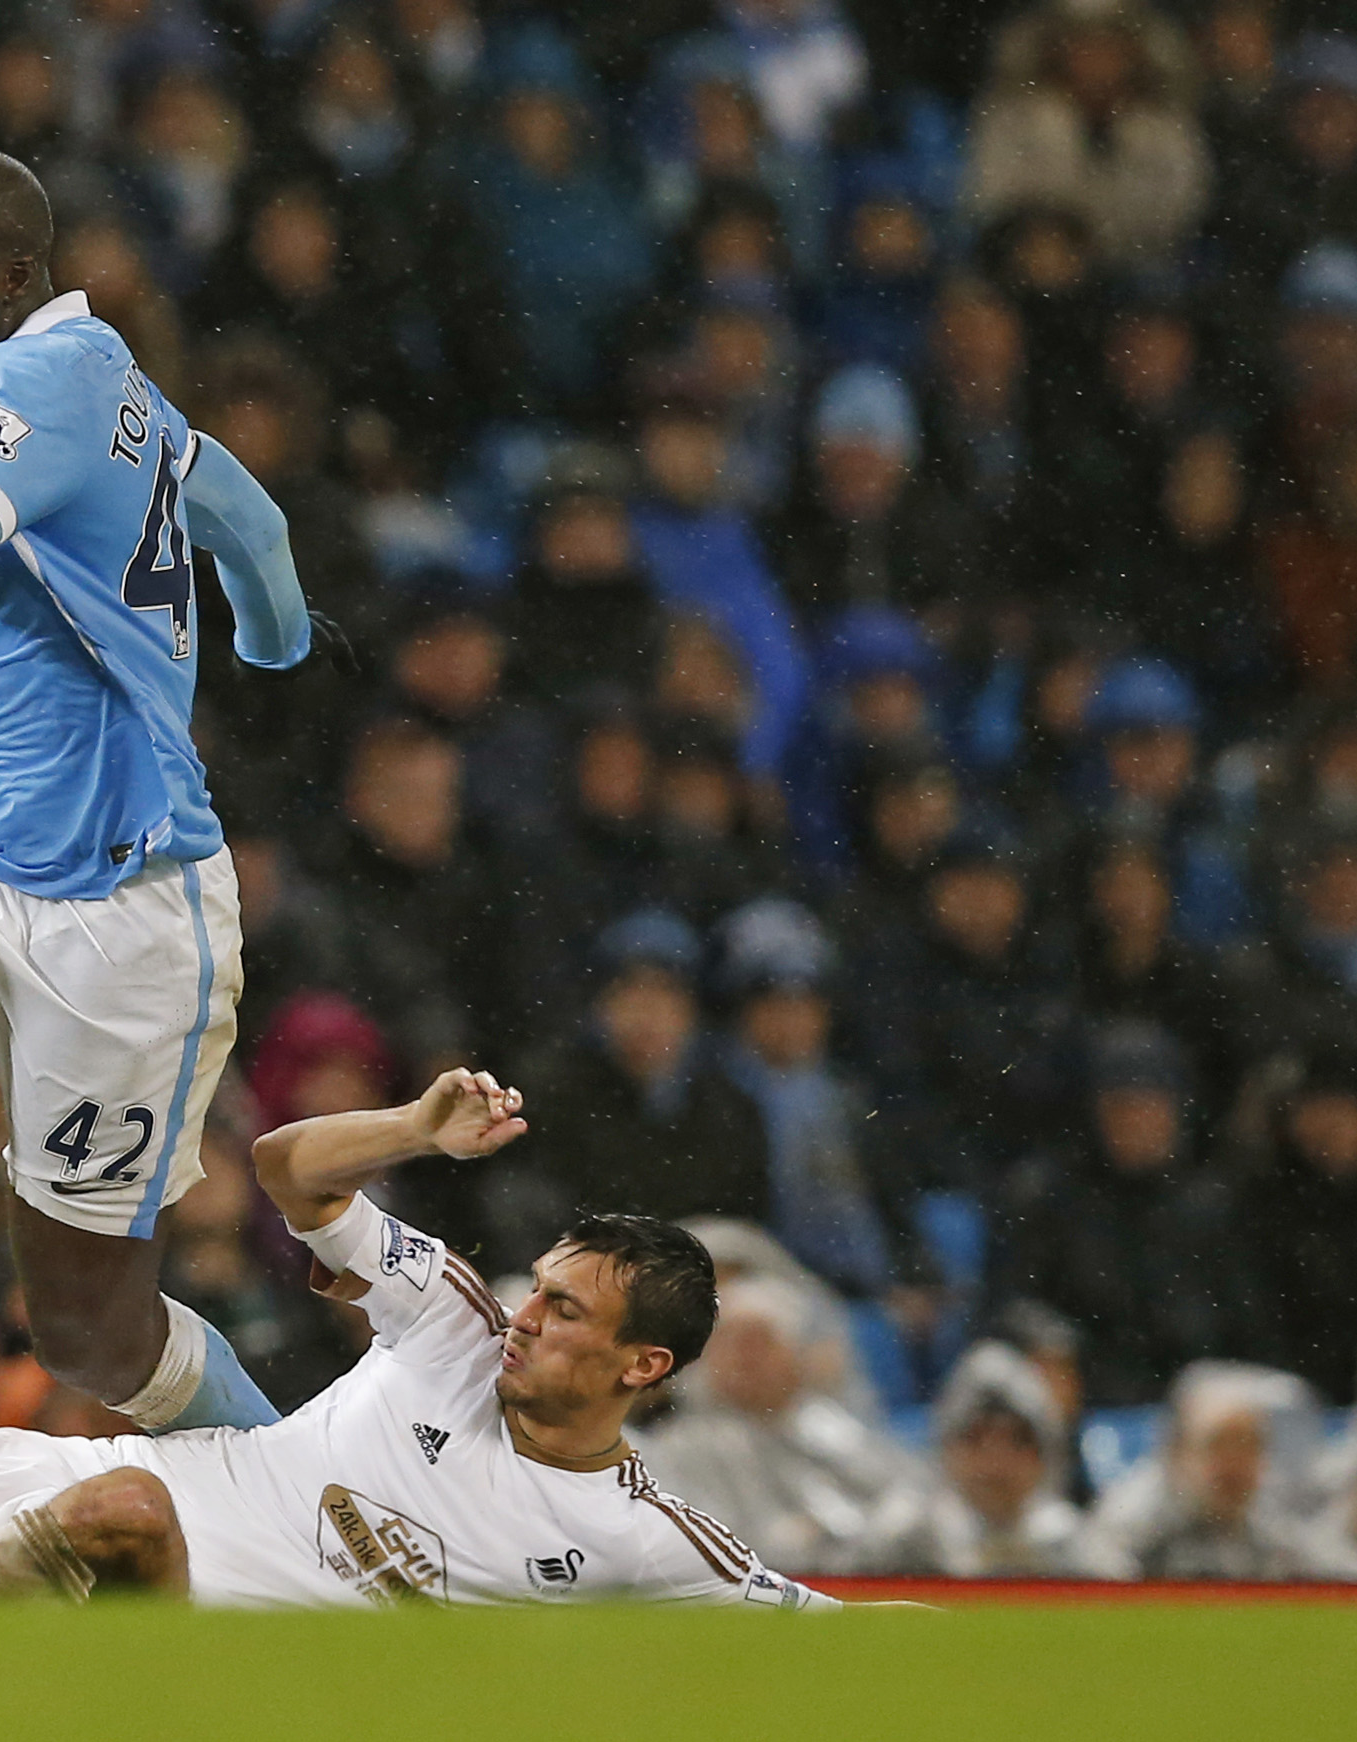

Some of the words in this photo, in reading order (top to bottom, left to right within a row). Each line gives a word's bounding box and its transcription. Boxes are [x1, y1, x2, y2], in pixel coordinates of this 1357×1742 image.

[42, 1097, 156, 1183] 42
[412, 1422, 438, 1465] adidas
[329, 1498, 379, 1565] 24k.hk
